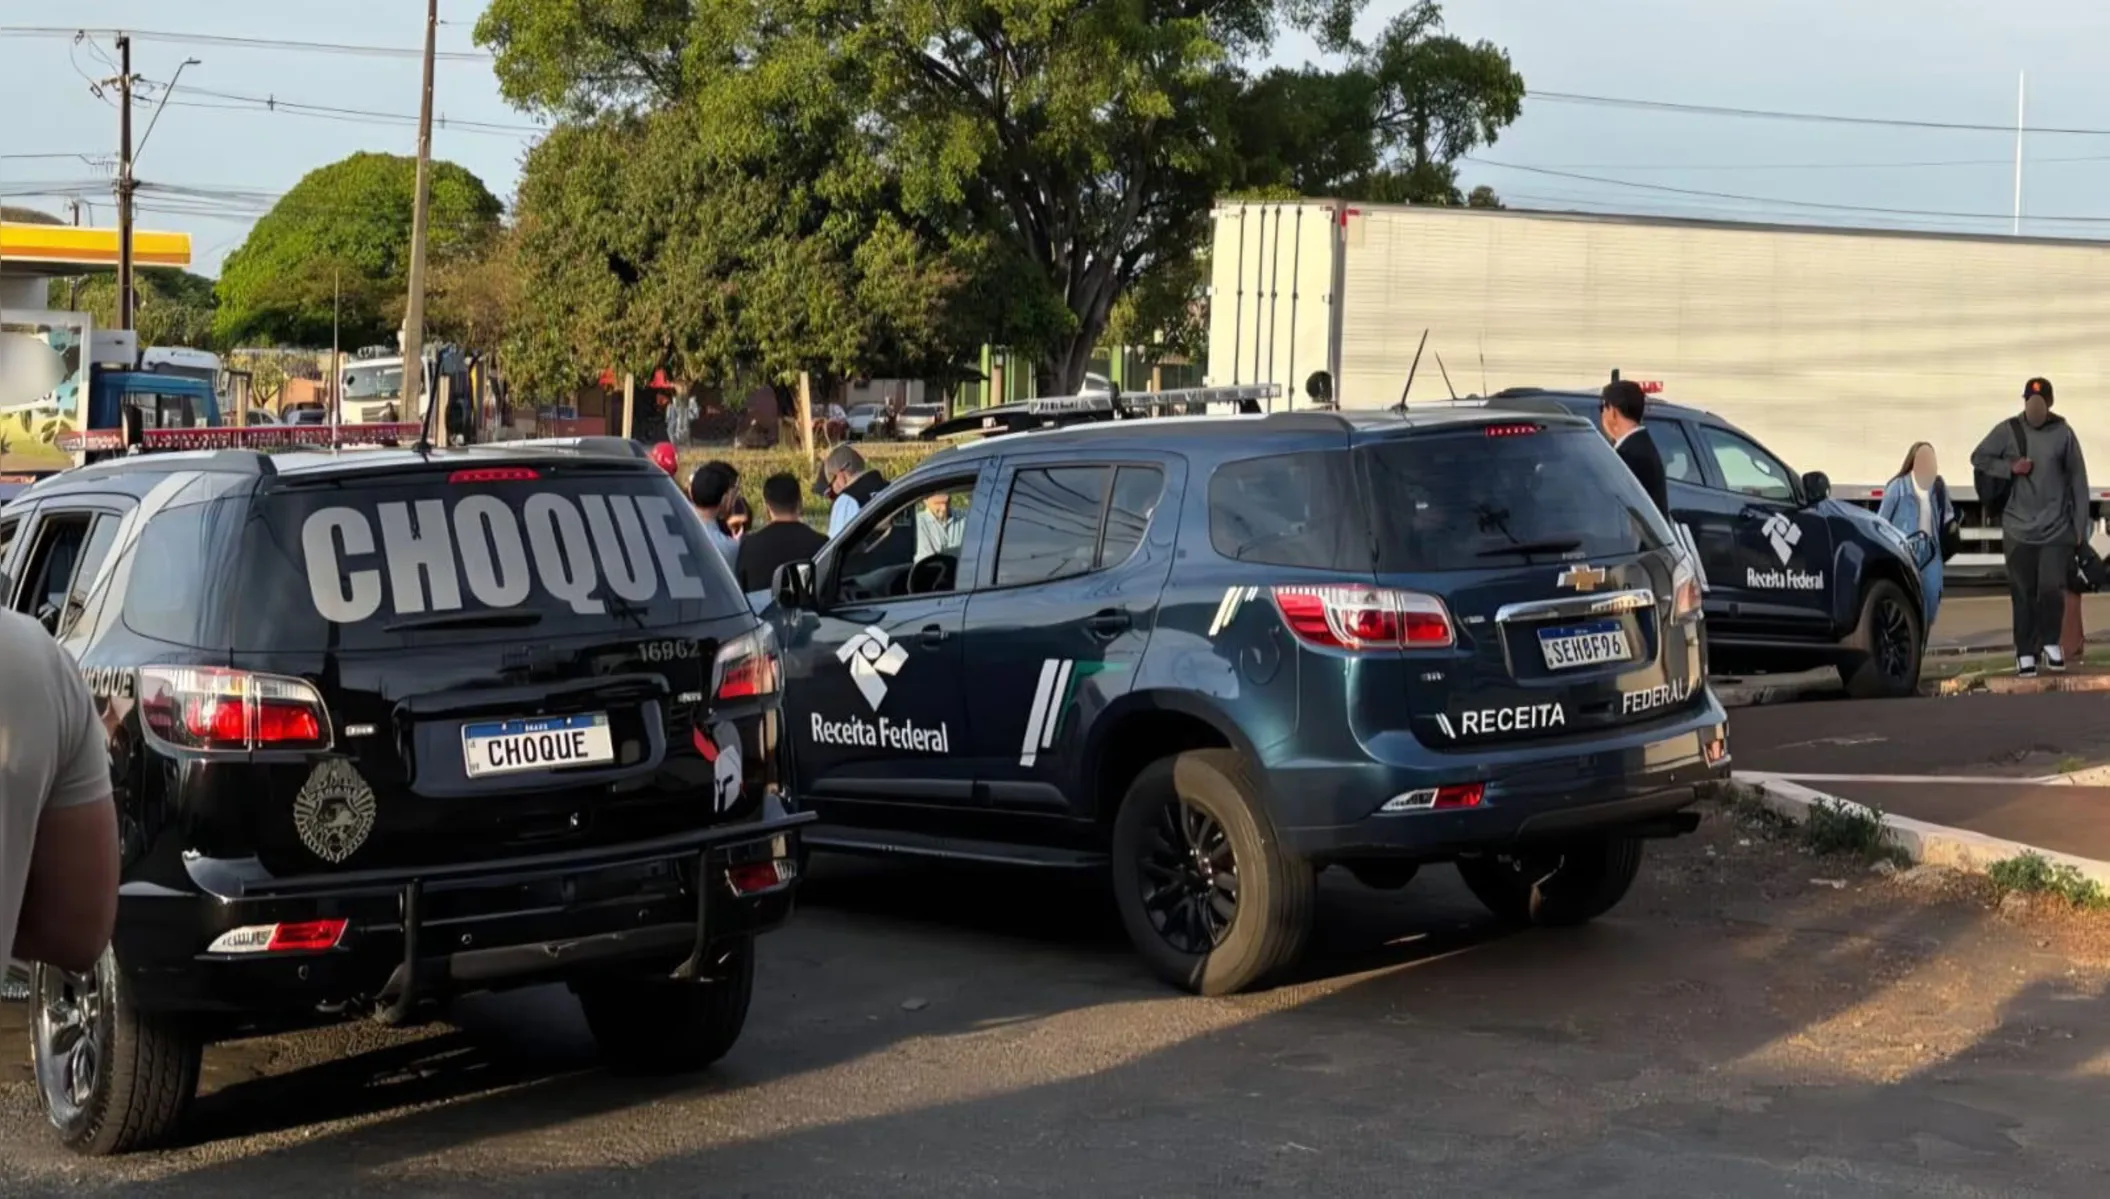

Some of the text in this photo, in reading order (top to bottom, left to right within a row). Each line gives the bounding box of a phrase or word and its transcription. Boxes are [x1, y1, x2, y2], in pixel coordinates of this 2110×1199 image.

[302, 492, 706, 623] CHOQUE
[1747, 567, 1824, 589] Receita Federal
[1552, 634, 1621, 663] SEH8F96
[80, 666, 134, 699] OQUE
[1461, 677, 1685, 735] RECEITA FEDERAL
[488, 731, 588, 766] CHOQUE
[811, 712, 949, 753] Receita Federal
